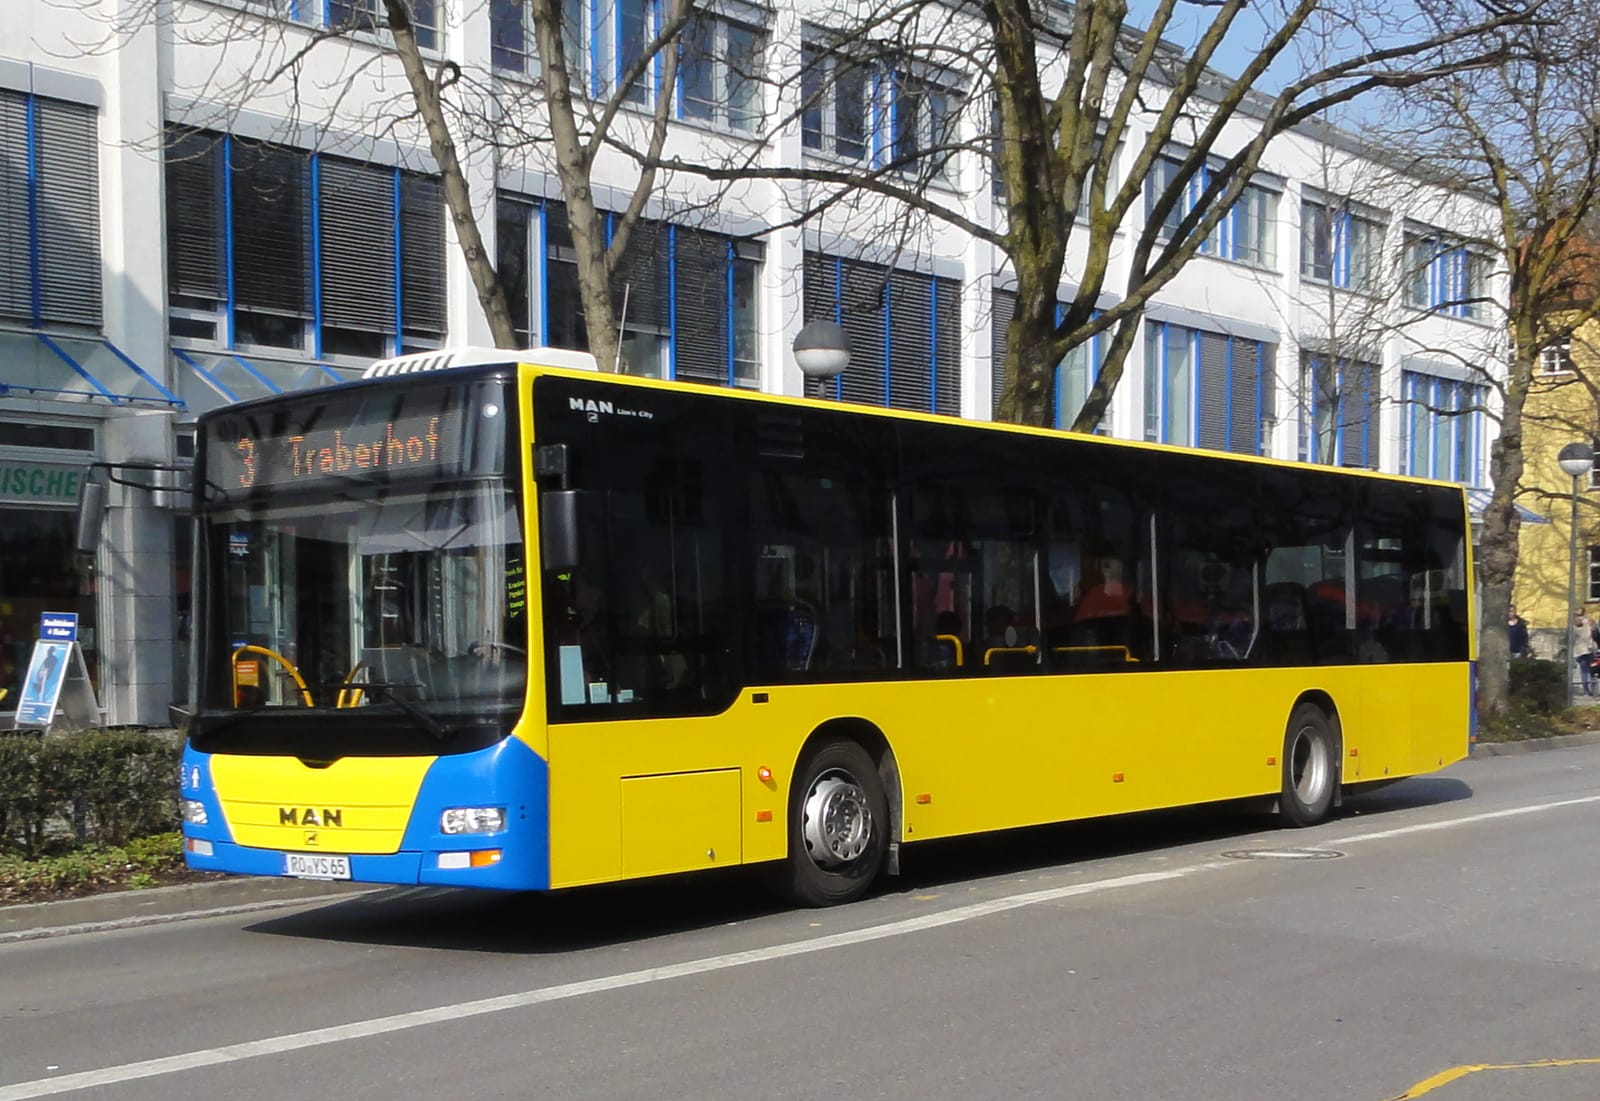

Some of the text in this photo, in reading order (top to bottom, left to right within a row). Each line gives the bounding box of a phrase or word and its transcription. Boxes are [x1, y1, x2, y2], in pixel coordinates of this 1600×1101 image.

[568, 397, 614, 414] MAN
[237, 416, 440, 488] 3 Traberhof
[0, 466, 96, 497] ISCHE
[279, 807, 342, 827] MAN
